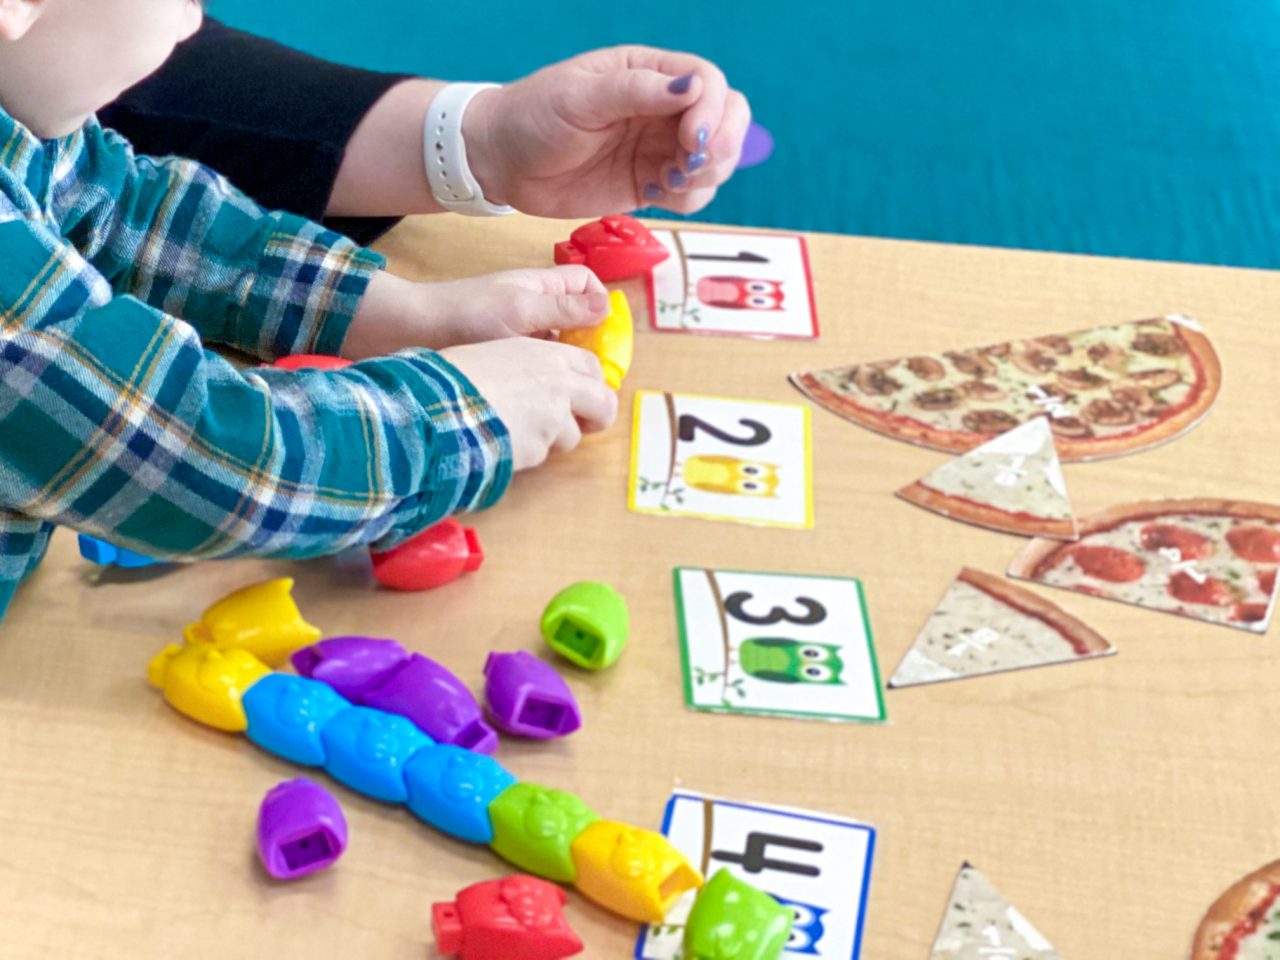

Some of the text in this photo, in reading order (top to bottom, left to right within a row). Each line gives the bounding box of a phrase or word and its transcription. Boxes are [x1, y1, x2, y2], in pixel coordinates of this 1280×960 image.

[688, 251, 770, 263] 1
[677, 413, 771, 447] 2
[722, 591, 827, 625] 3
[709, 831, 823, 877] 4
